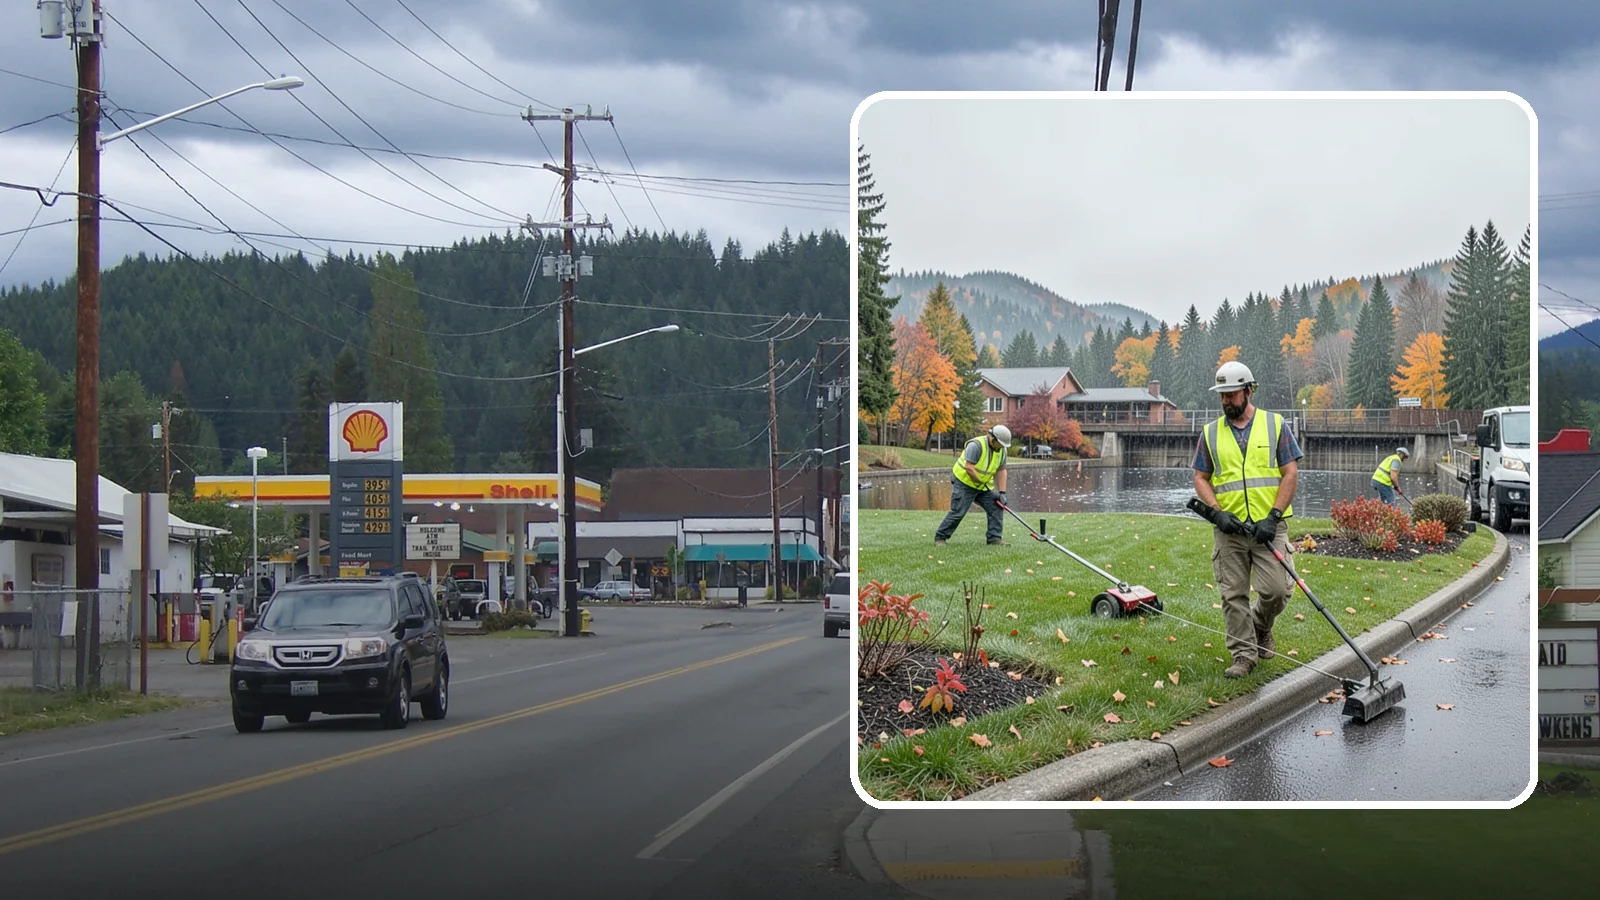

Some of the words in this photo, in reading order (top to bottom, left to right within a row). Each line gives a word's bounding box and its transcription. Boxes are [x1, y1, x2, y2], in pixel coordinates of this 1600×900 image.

[365, 480, 384, 490] 395
[490, 485, 547, 499] Shell
[365, 494, 384, 504] 405
[365, 508, 384, 518] 415
[365, 522, 384, 532] 429
